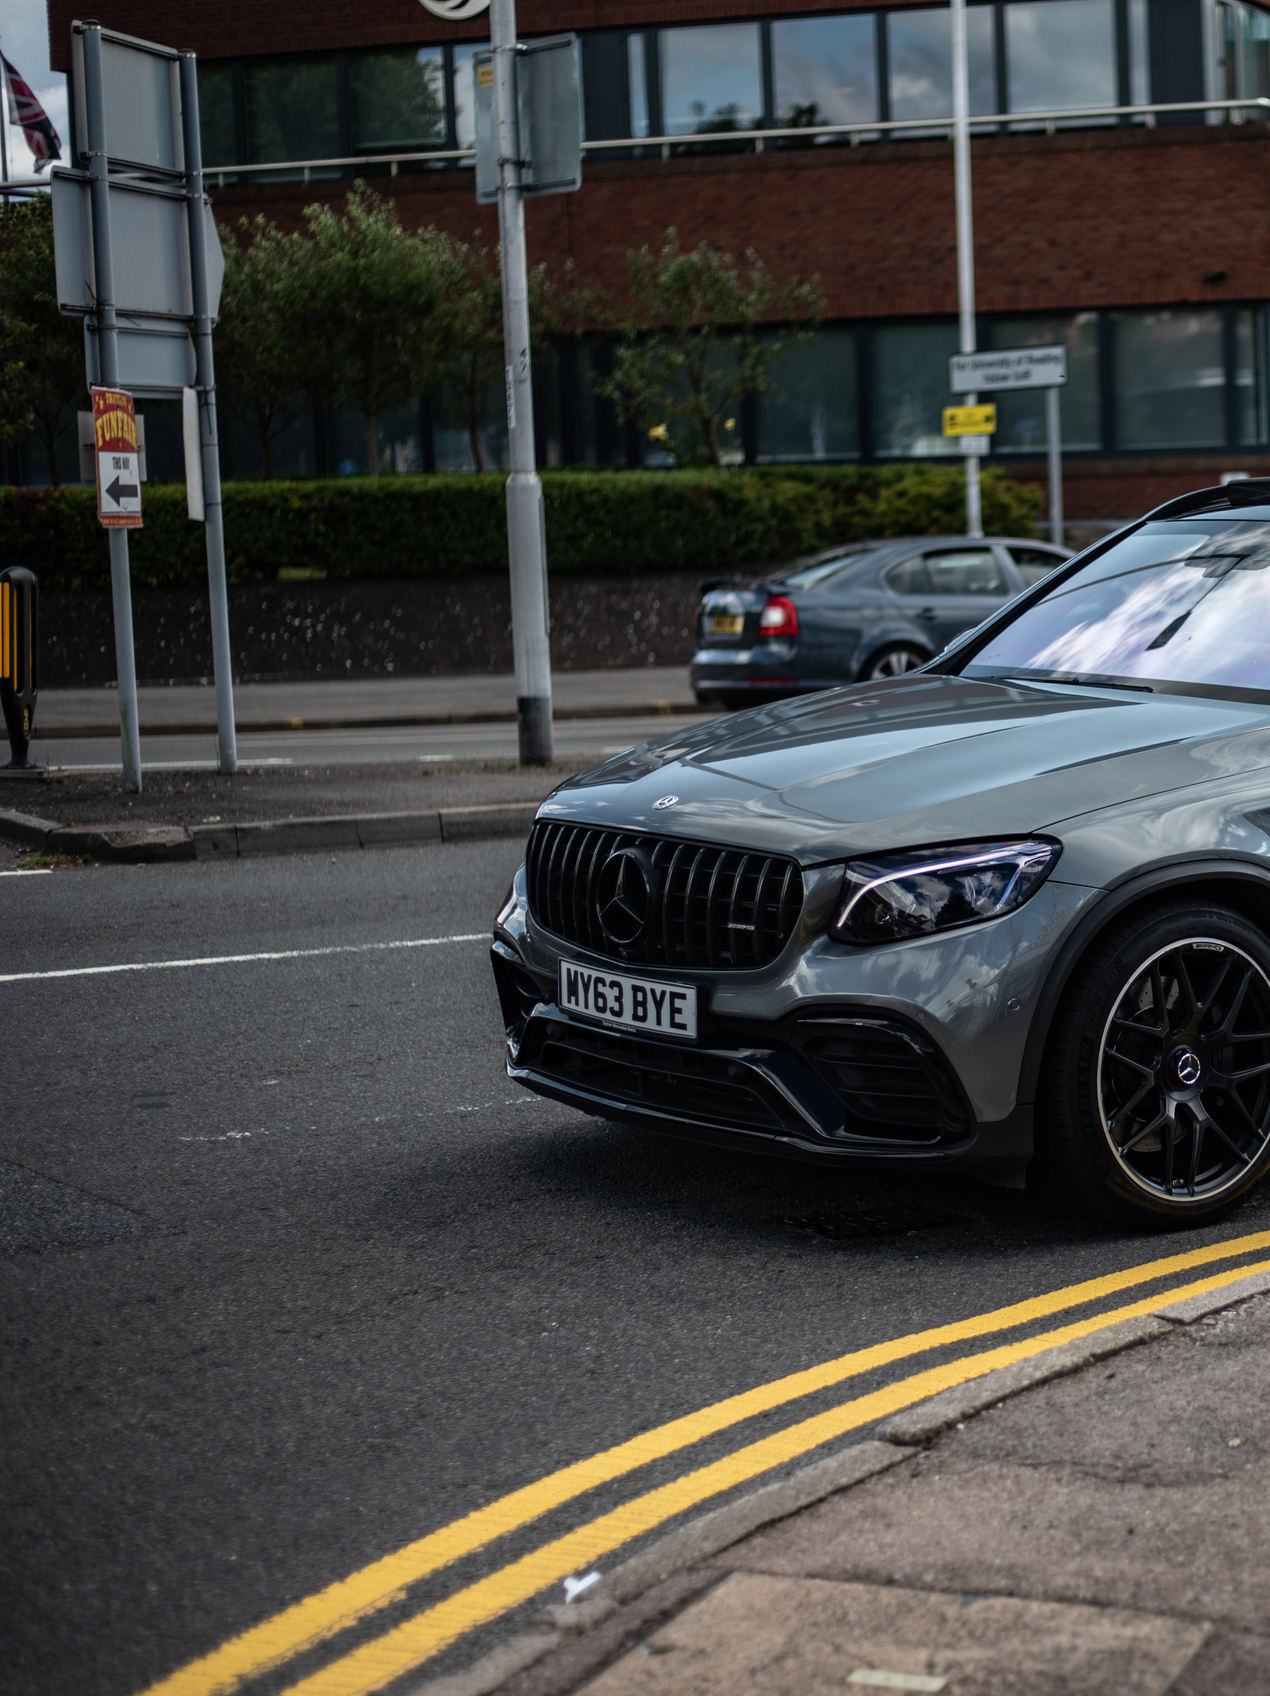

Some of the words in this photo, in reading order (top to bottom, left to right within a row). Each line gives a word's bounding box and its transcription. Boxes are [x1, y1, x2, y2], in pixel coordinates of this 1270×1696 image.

[95, 410, 137, 450] FUNFAIR
[112, 456, 122, 470] THIS
[122, 456, 130, 470] WAY
[567, 967, 624, 1018] MY63
[632, 984, 687, 1031] BYE
